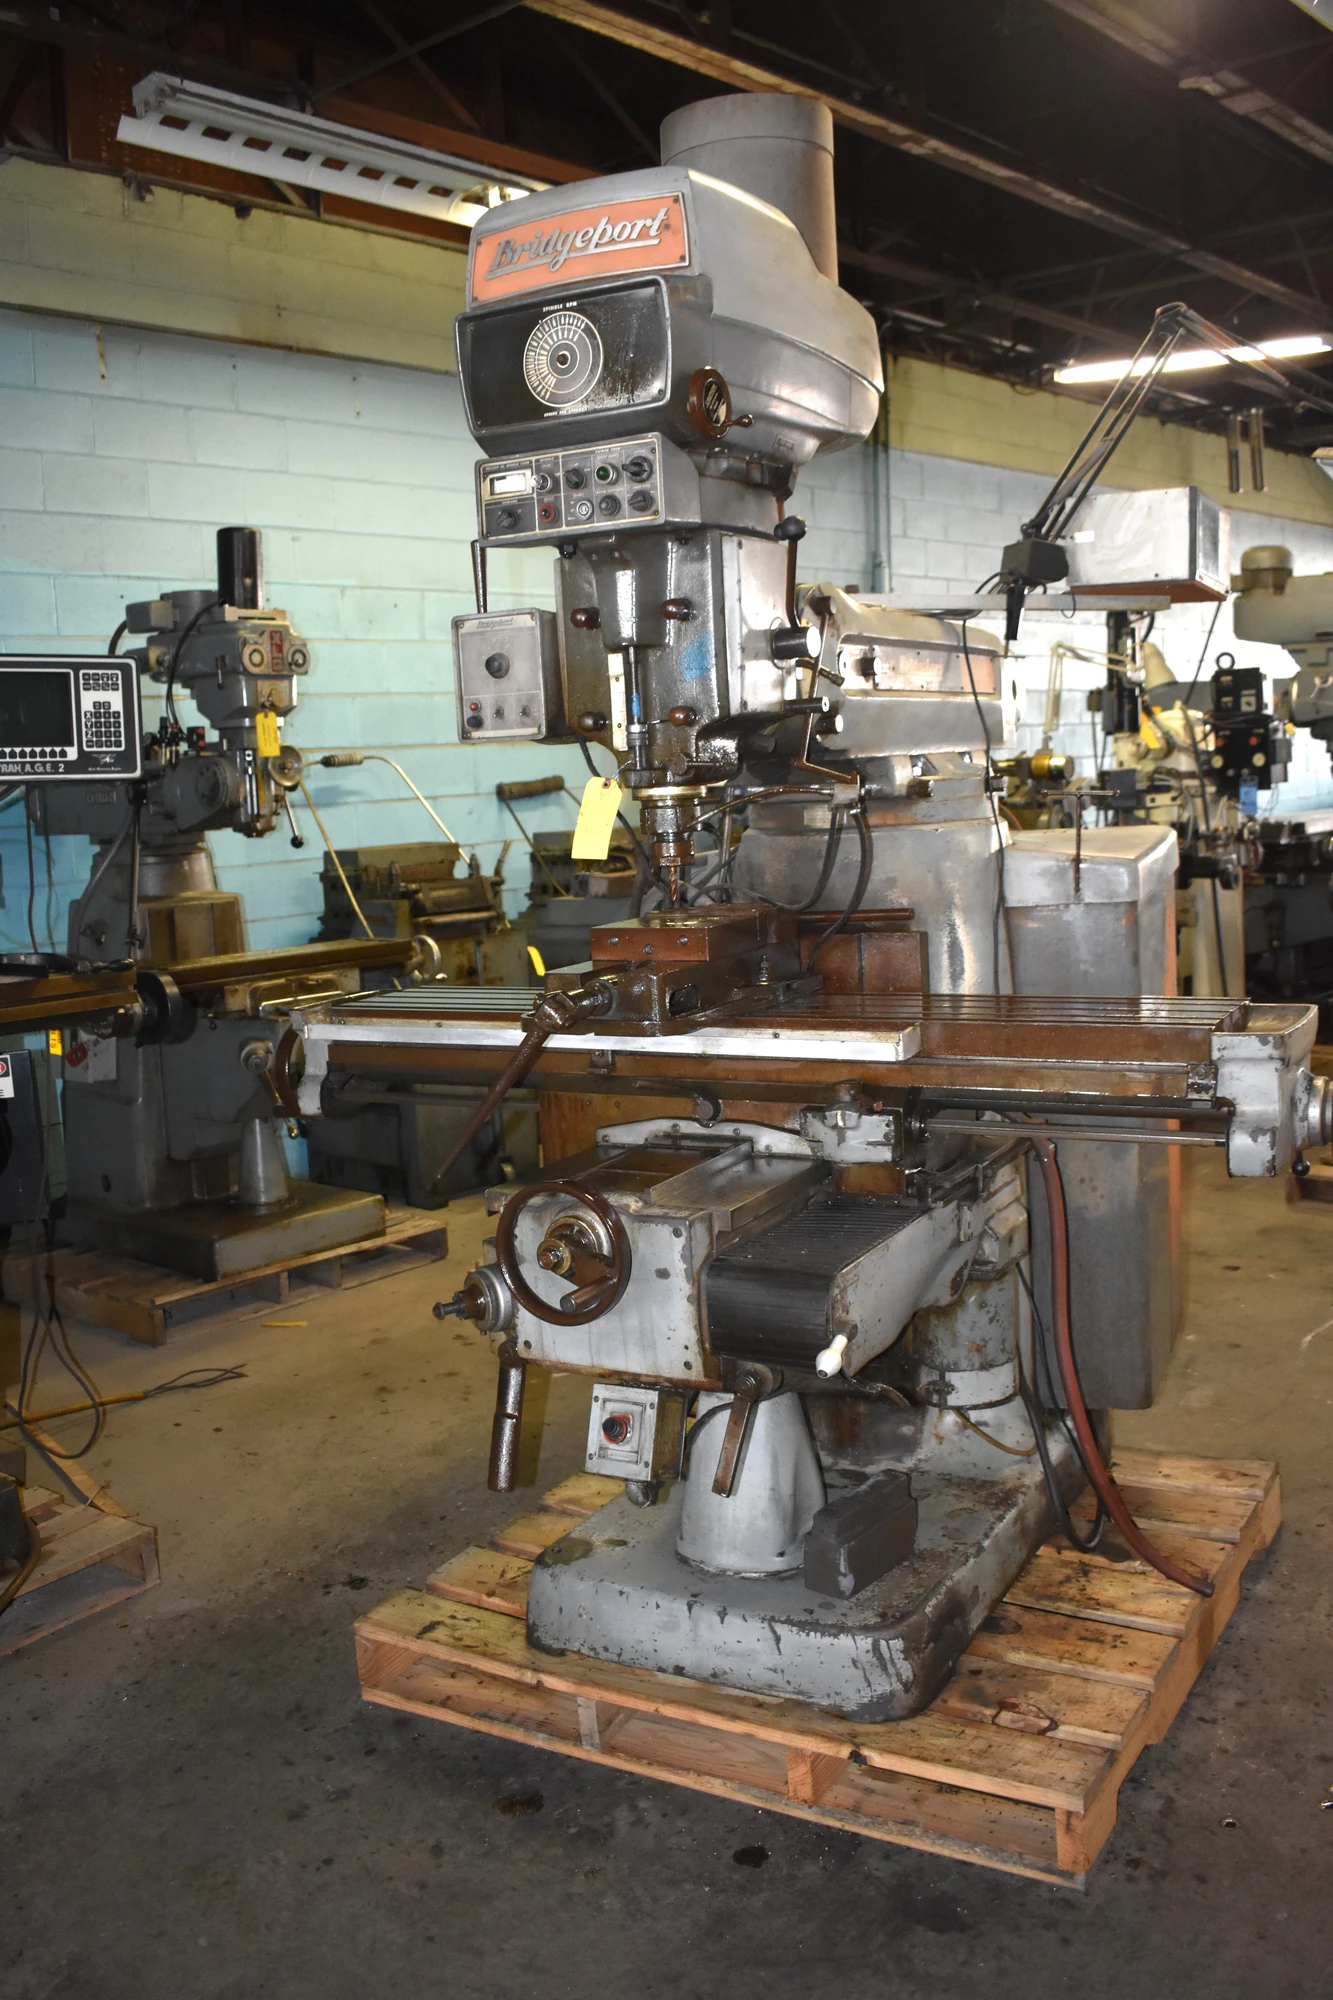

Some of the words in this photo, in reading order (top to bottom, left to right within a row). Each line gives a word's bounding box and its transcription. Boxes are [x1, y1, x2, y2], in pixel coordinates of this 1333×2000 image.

[487, 207, 669, 273] Bridgeport
[85, 711, 92, 719] X
[25, 763, 54, 773] A.G.E.
[58, 763, 65, 772] 2
